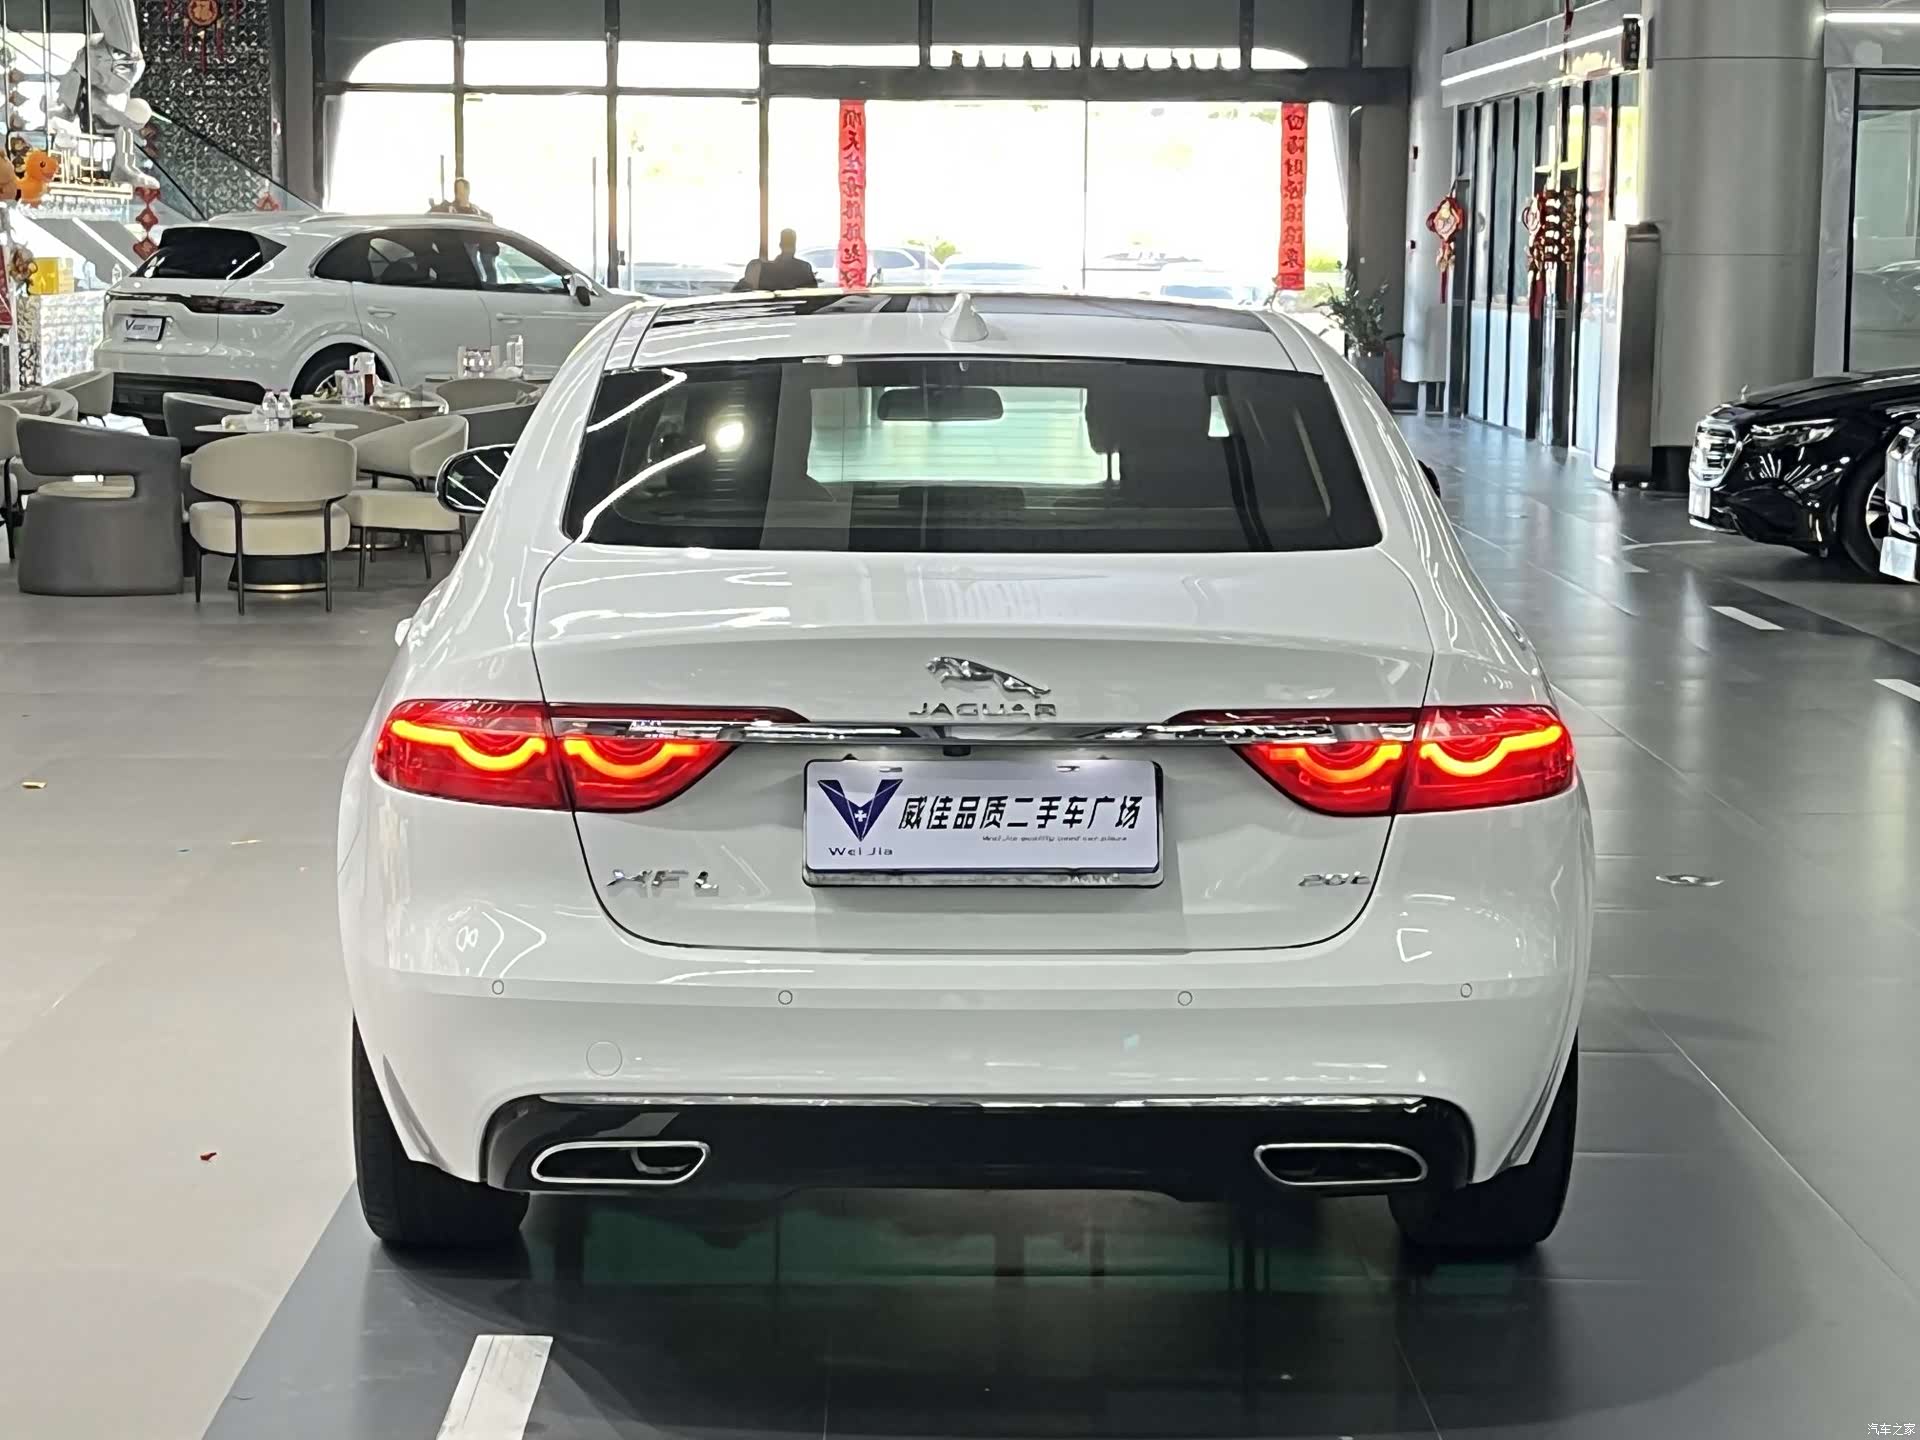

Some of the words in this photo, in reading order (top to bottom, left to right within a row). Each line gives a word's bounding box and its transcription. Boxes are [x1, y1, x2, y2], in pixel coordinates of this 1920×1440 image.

[908, 702, 1056, 717] JAGUAR
[898, 795, 1143, 830] 威佳品质二手车广场
[828, 847, 862, 856] Wei
[866, 847, 893, 856] Jia
